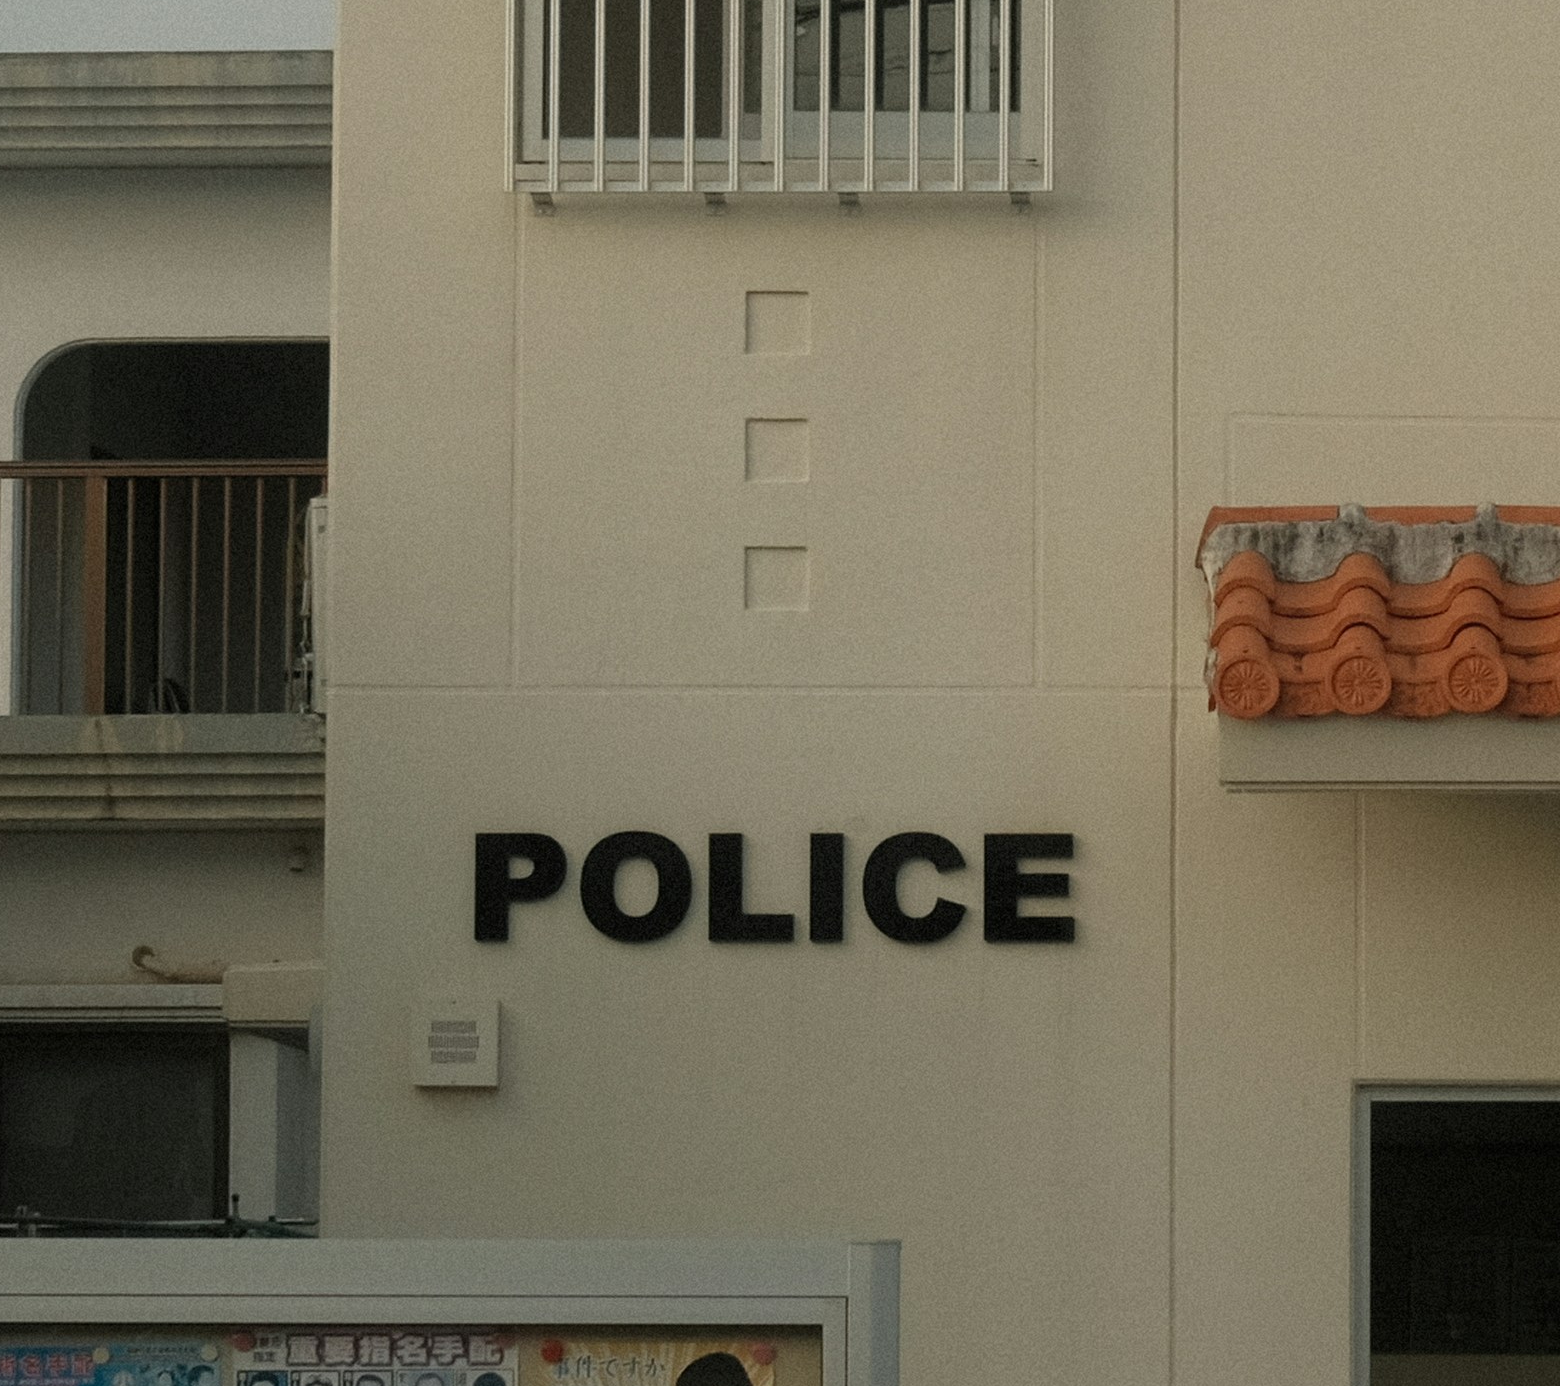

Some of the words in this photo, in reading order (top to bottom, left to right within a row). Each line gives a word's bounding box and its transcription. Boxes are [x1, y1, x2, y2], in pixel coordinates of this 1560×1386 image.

[474, 830, 1075, 944] POLICE
[553, 1356, 666, 1378] 事件ですか
